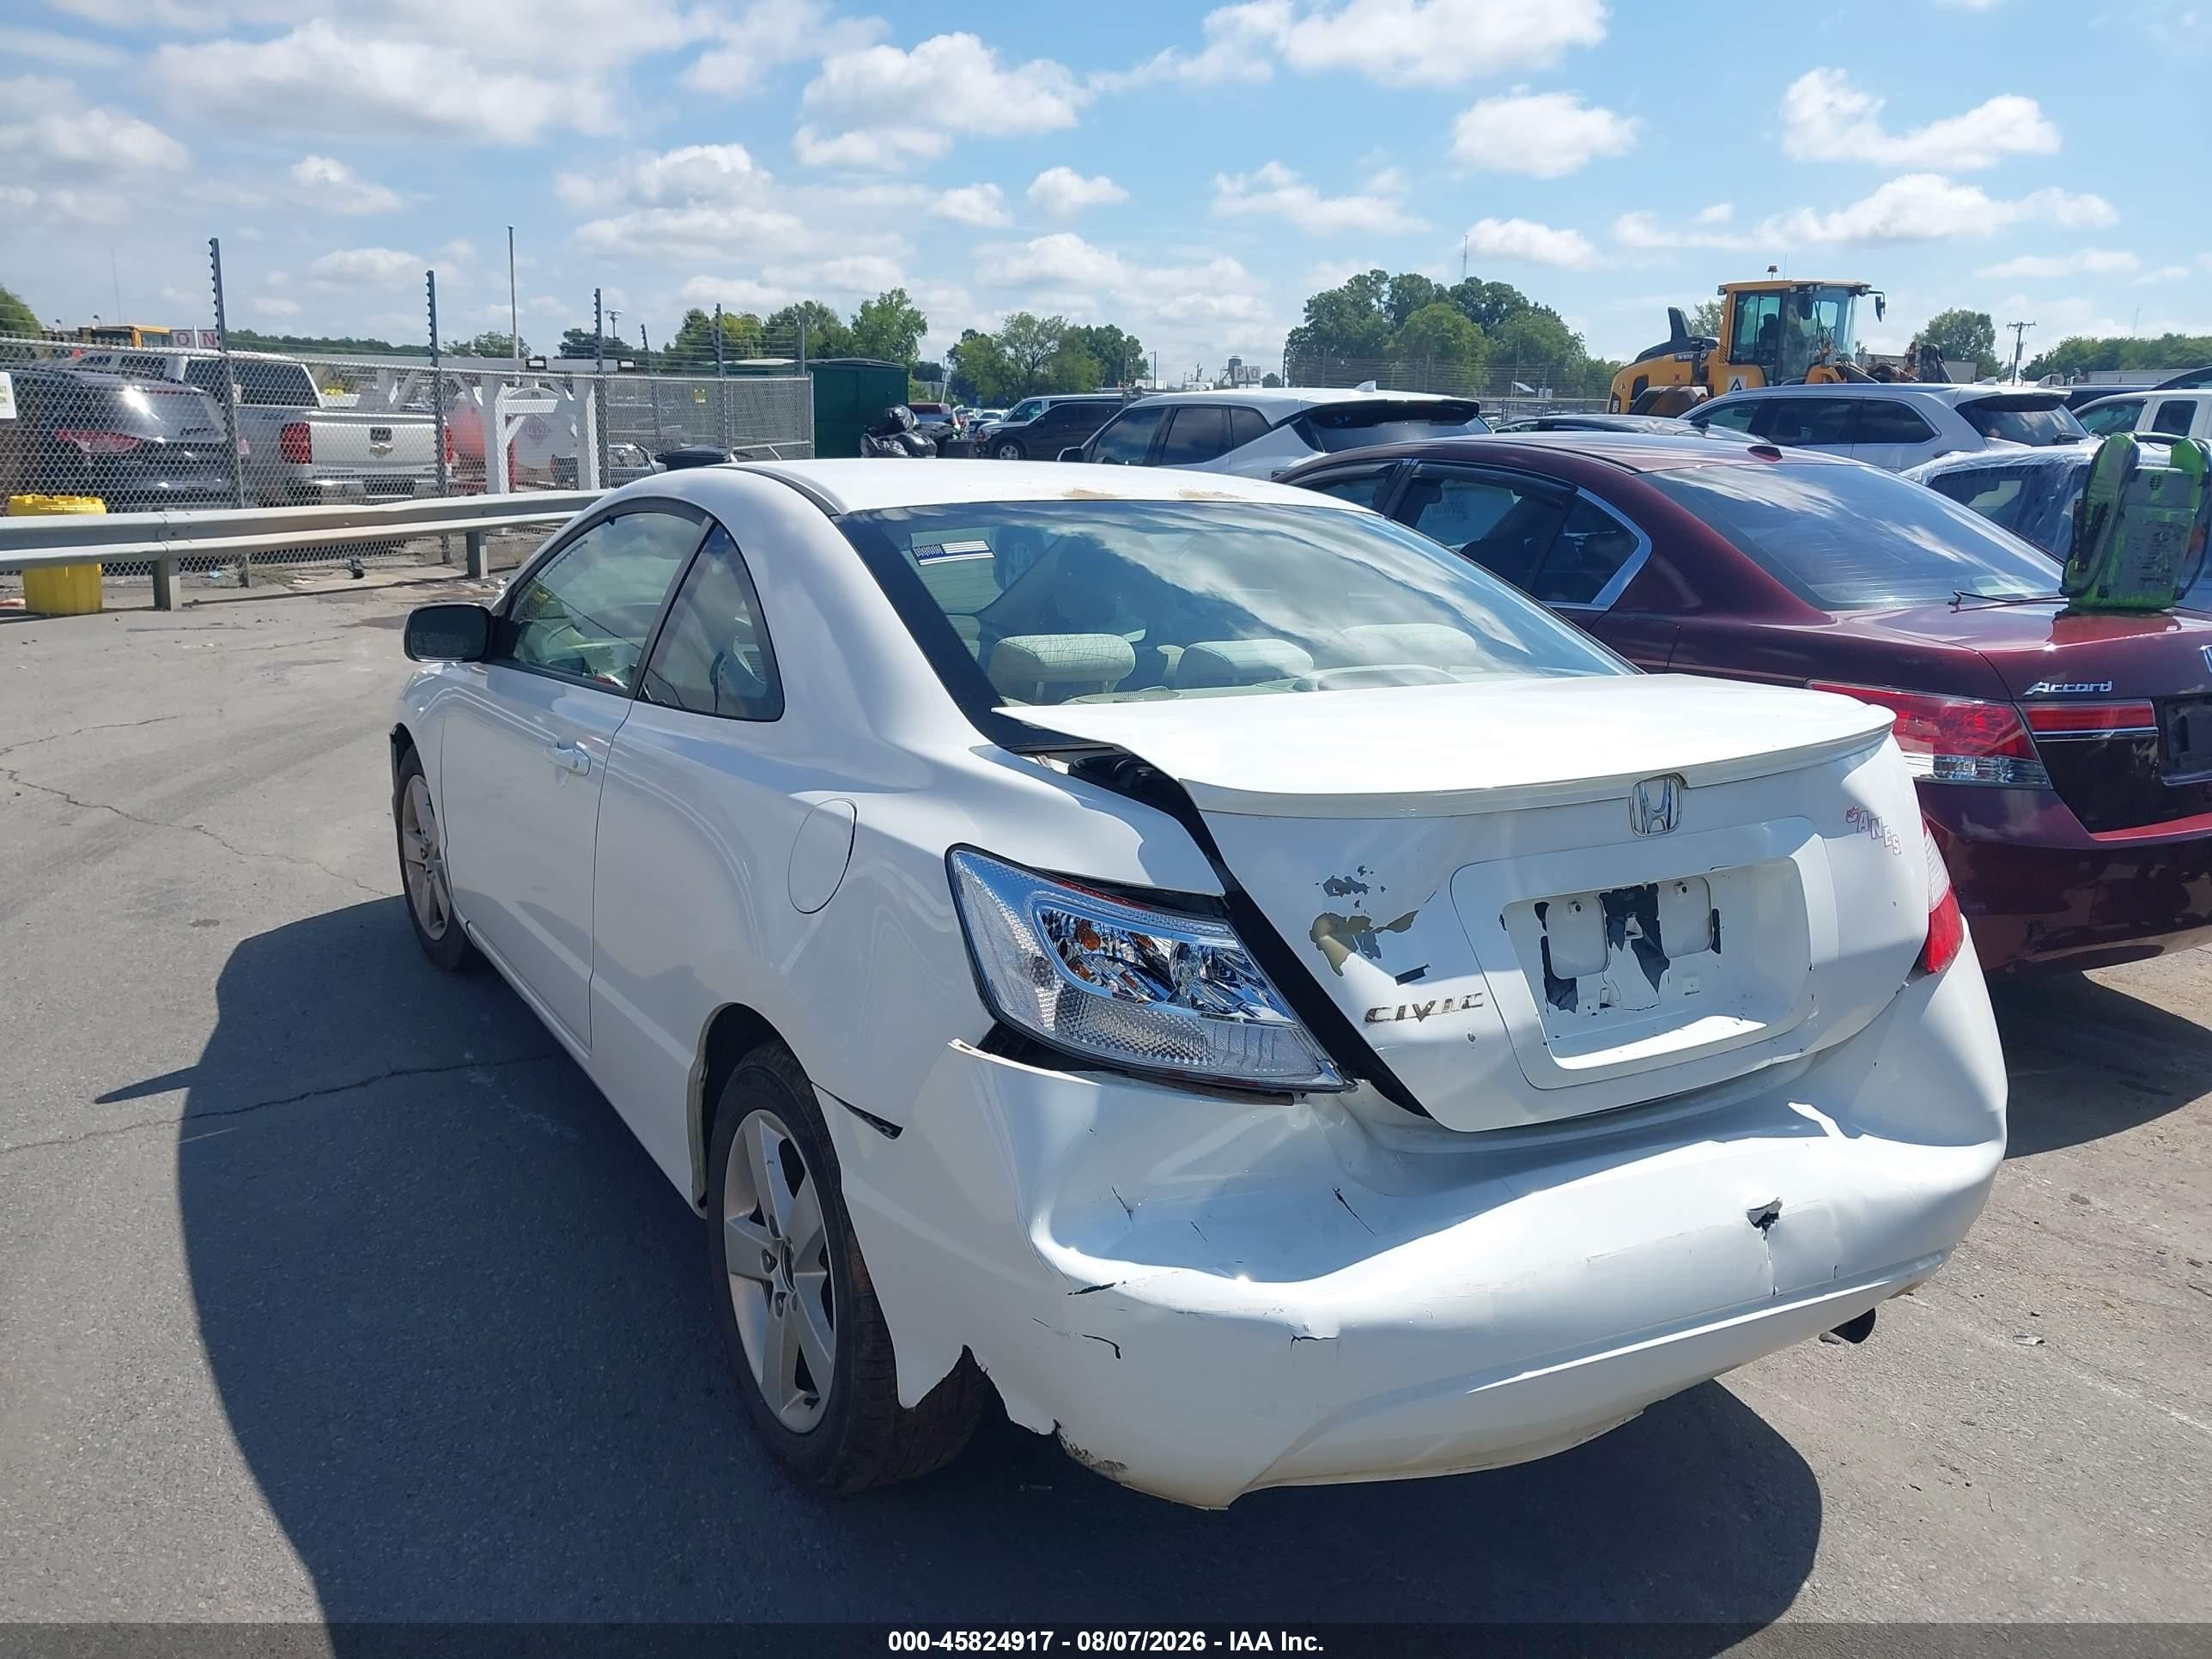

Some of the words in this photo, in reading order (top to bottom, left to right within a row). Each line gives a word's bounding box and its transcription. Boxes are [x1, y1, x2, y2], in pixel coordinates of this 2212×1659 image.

[1237, 368, 1243, 379] P
[2022, 681, 2112, 696] Accord
[1364, 992, 1483, 1023] CIVIC
